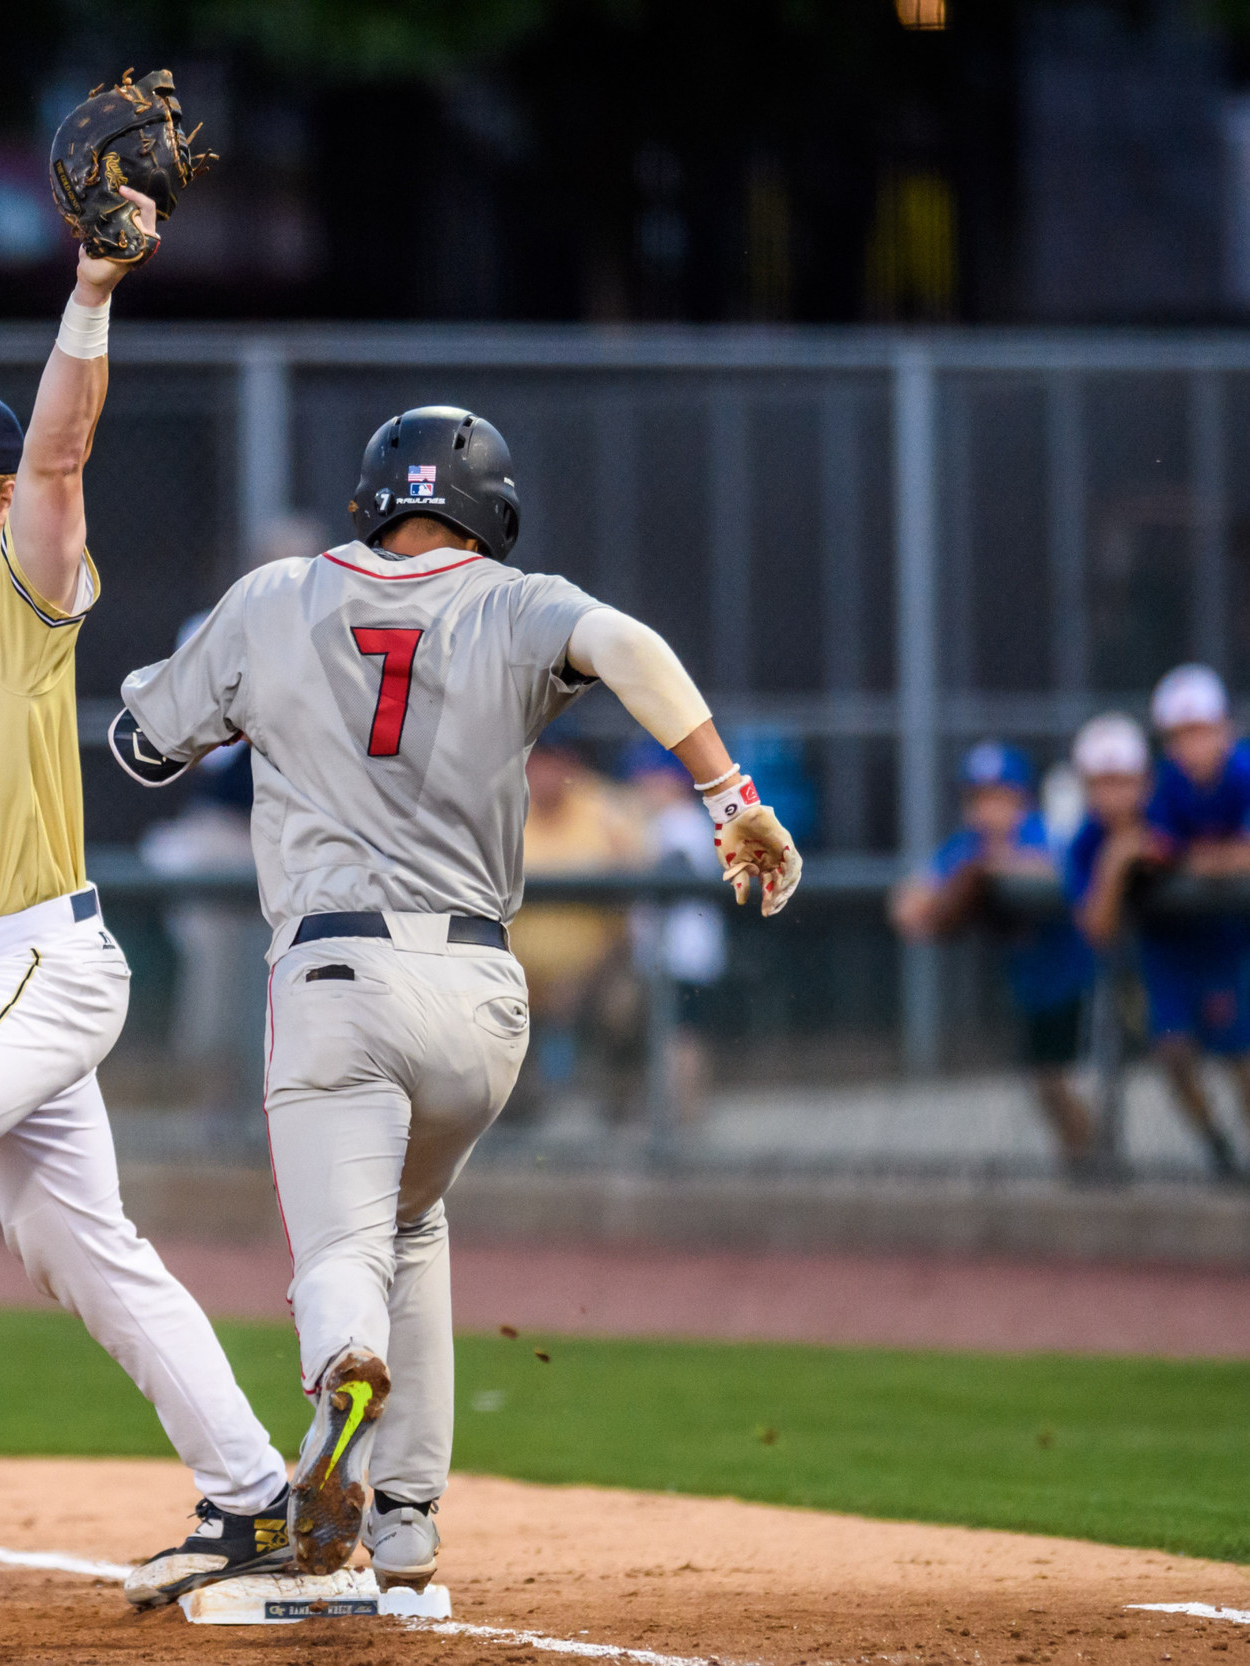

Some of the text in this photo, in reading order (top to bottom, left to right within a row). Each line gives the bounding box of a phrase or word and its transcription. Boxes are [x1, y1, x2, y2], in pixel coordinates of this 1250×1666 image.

[380, 493, 390, 511] 7
[396, 497, 446, 505] RAWLINGS
[350, 626, 425, 757] 7
